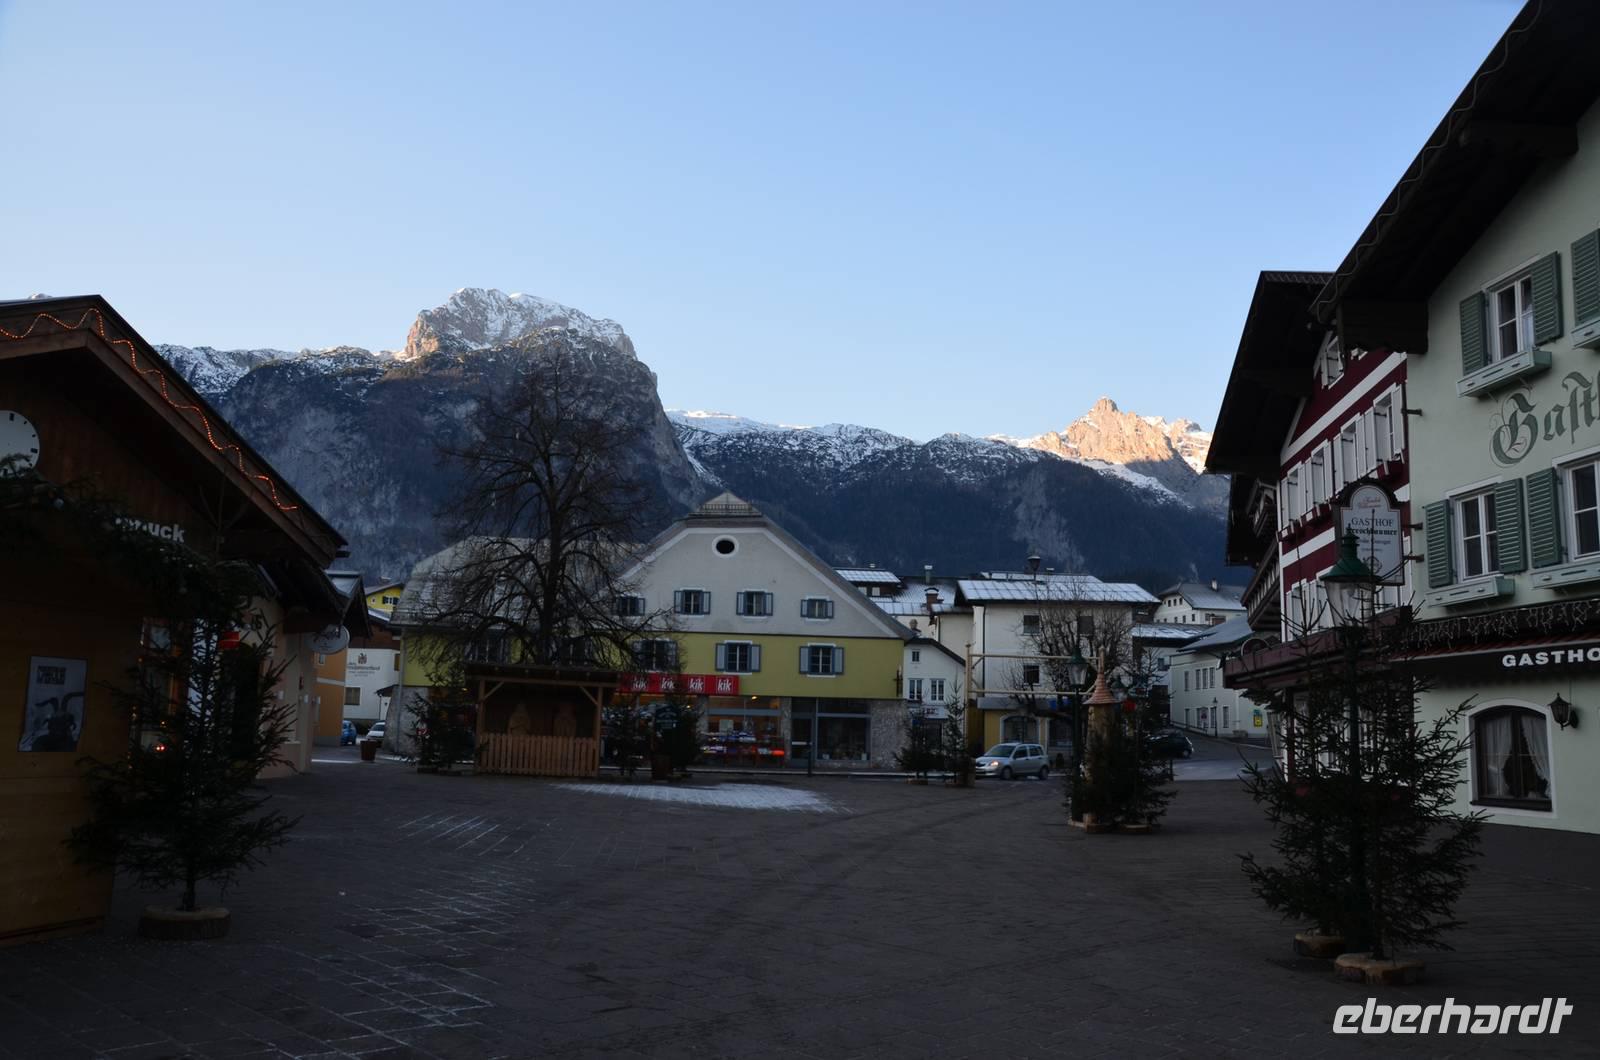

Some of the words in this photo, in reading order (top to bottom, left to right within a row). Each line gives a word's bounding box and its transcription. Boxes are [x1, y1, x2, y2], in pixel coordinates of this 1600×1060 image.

[1490, 371, 1600, 468] Gast
[1501, 646, 1600, 668] GASTHO
[689, 677, 705, 691] kik
[717, 679, 732, 692] kik
